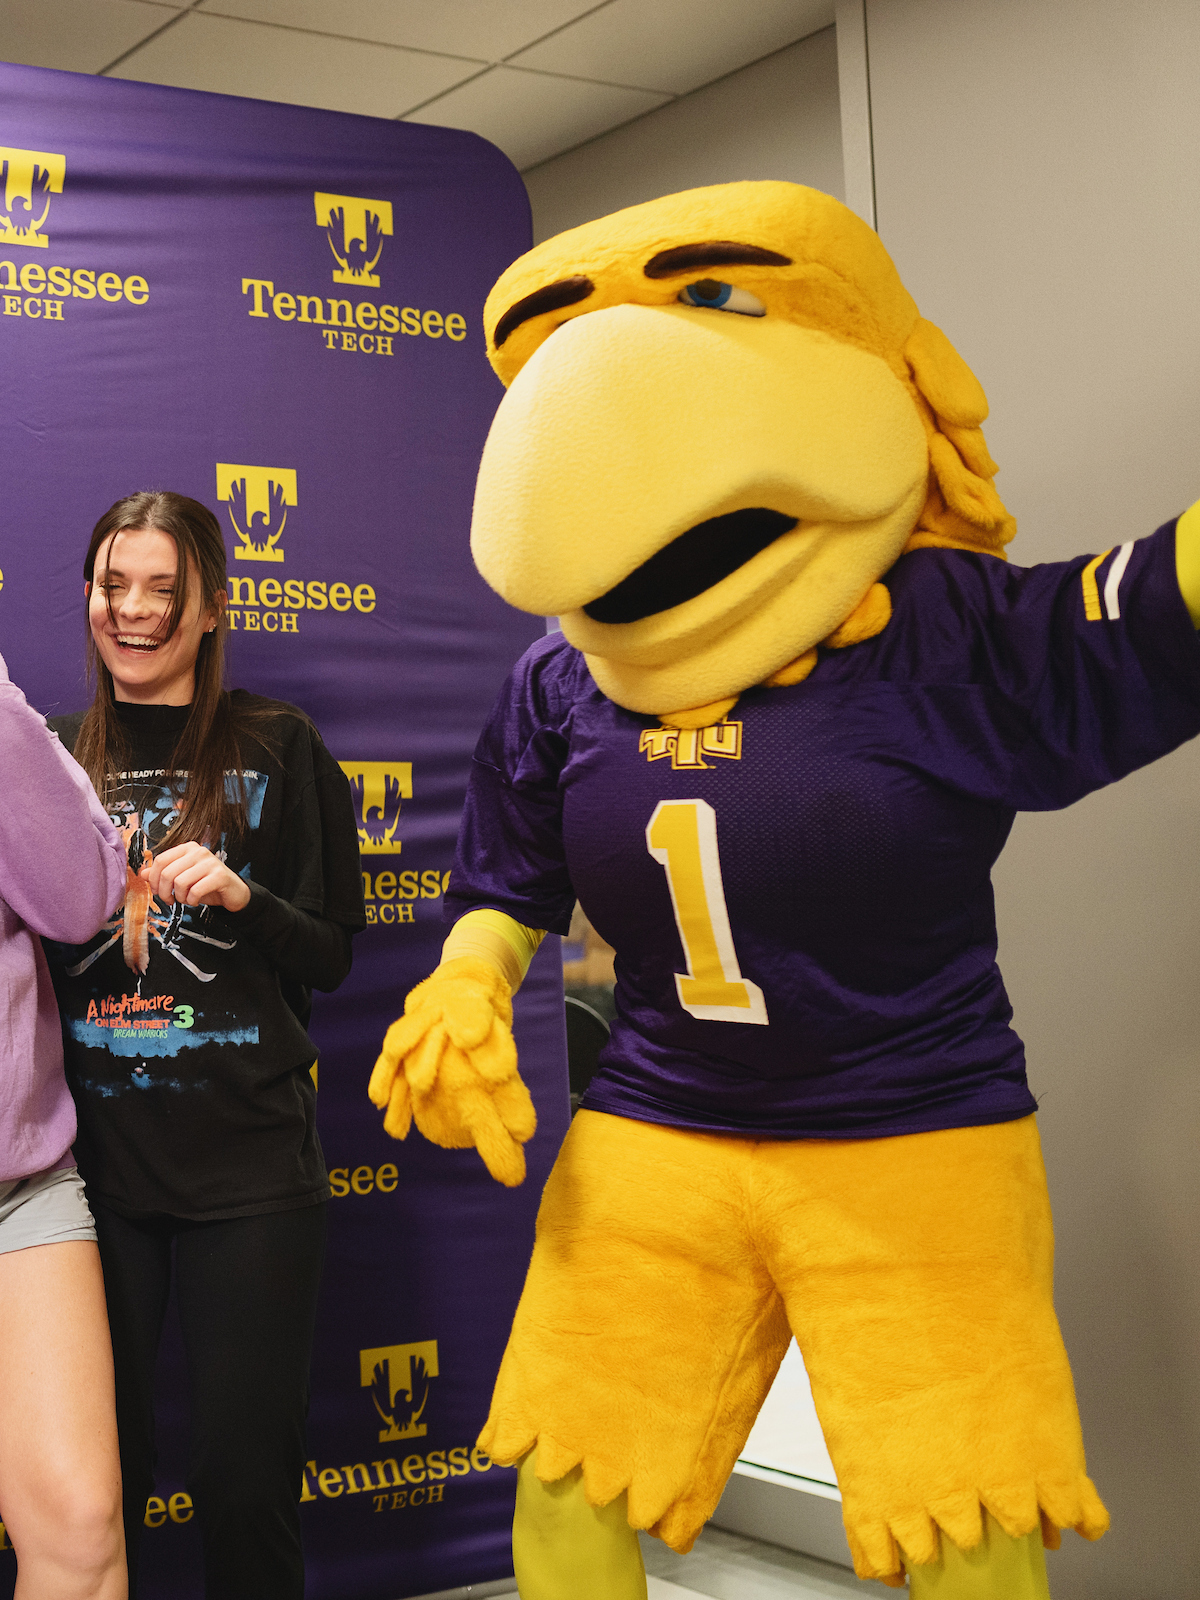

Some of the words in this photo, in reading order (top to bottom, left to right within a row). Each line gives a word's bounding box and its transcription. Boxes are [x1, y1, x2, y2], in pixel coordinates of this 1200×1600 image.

[241, 278, 467, 342] Tennessee
[322, 330, 394, 356] TECH
[224, 576, 376, 613] nessee
[224, 609, 300, 633] TECH
[365, 902, 416, 925] ECH
[645, 798, 770, 1026] 1
[85, 998, 99, 1025] A
[100, 992, 175, 1021] Nightmare
[172, 1004, 195, 1029] 3
[94, 1018, 110, 1028] ON
[110, 1019, 132, 1029] ELM
[132, 1019, 171, 1030] STREET
[113, 1028, 138, 1039] DREAM
[137, 1029, 169, 1040] WARRIORS
[372, 1483, 445, 1513] TECH
